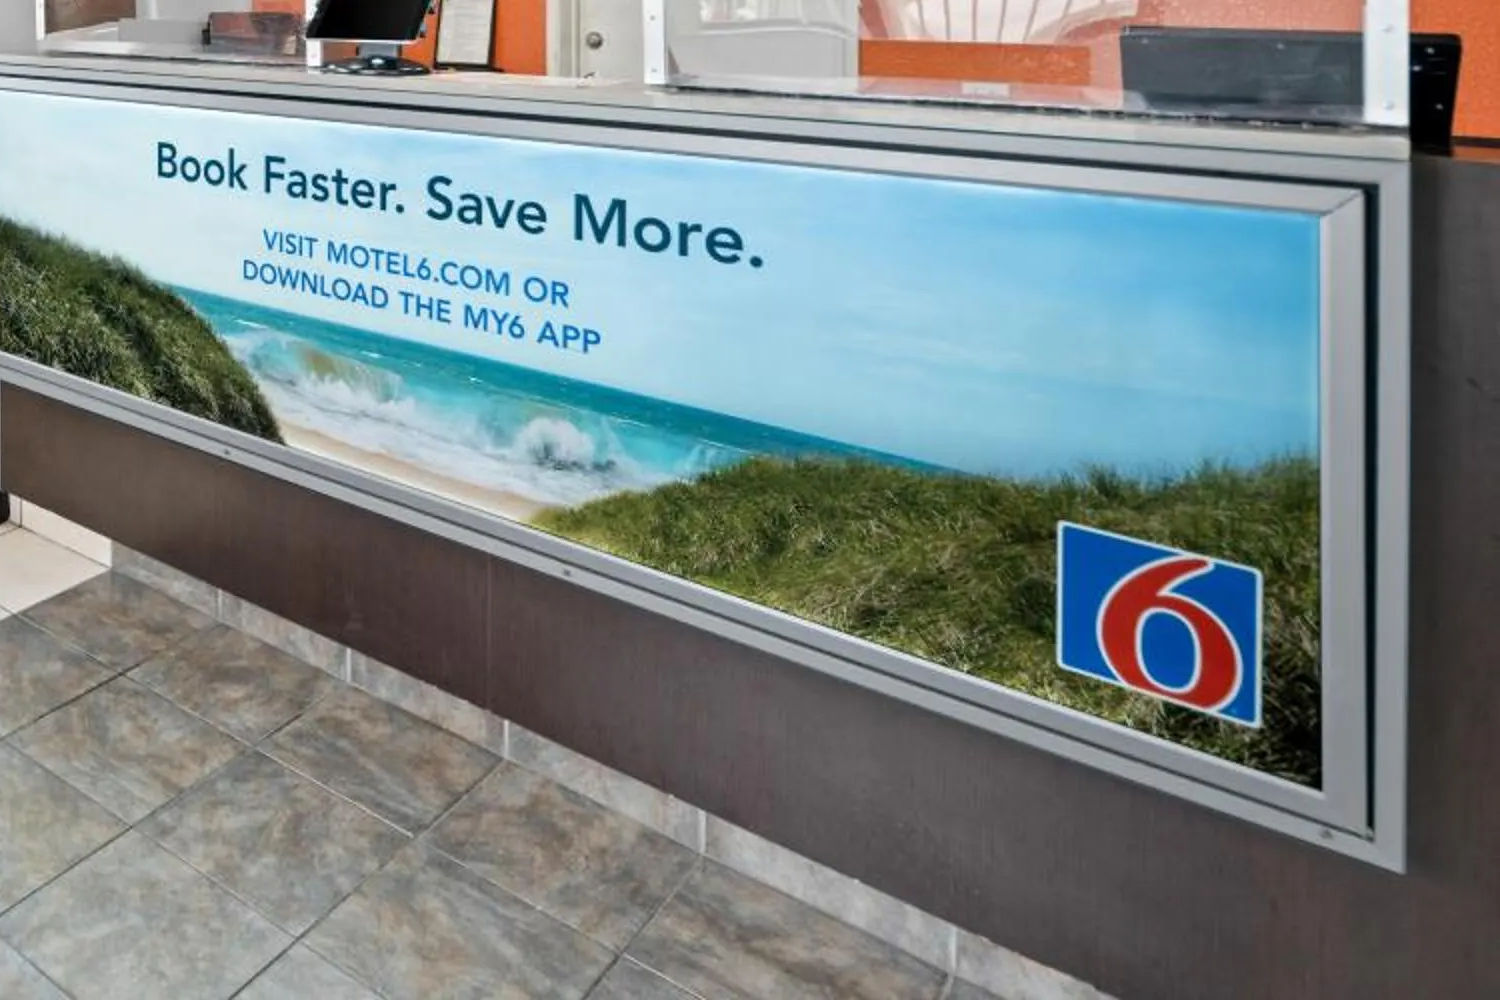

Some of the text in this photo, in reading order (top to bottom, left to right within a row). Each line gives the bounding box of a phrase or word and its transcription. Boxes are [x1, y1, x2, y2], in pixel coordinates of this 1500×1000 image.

[156, 140, 764, 269] Book Faster. Save More.
[242, 258, 602, 355] DOWNLOAD THE MY6 APP
[262, 228, 570, 309] VISIT MOTEL6.COM OR
[1096, 555, 1243, 713] 6
